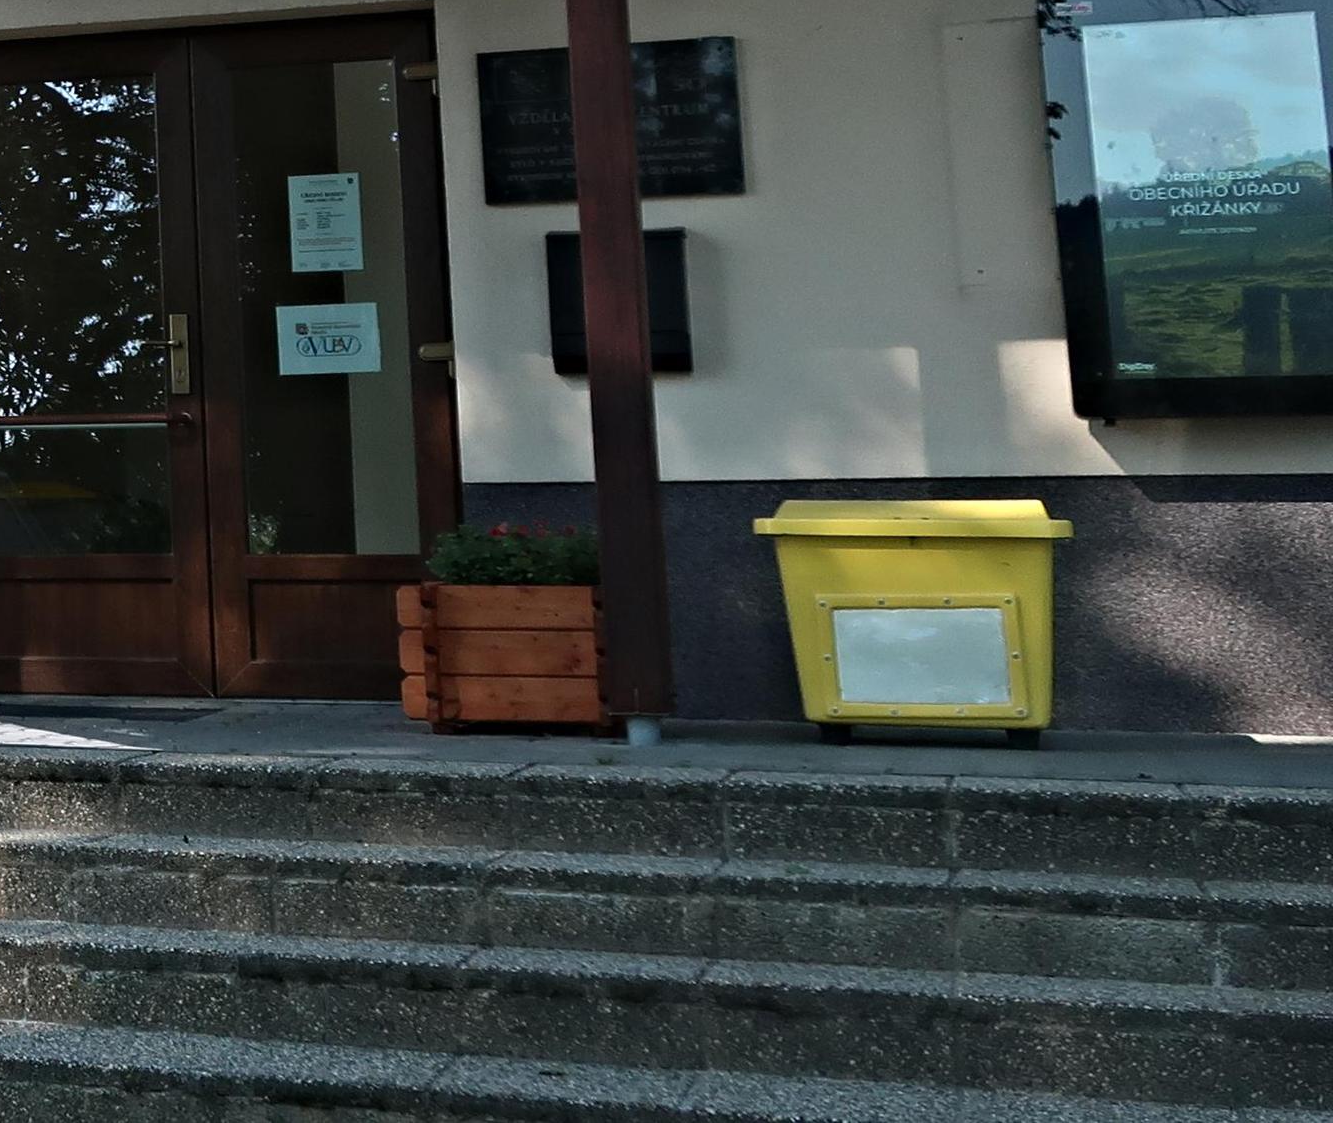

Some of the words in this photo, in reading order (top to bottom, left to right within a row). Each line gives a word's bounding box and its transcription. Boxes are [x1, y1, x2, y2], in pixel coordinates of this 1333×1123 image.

[1129, 183, 1228, 201] OBECNÍHO
[1233, 181, 1301, 197] ÚŘADU
[1170, 200, 1261, 217] KŘIŽÁNKY
